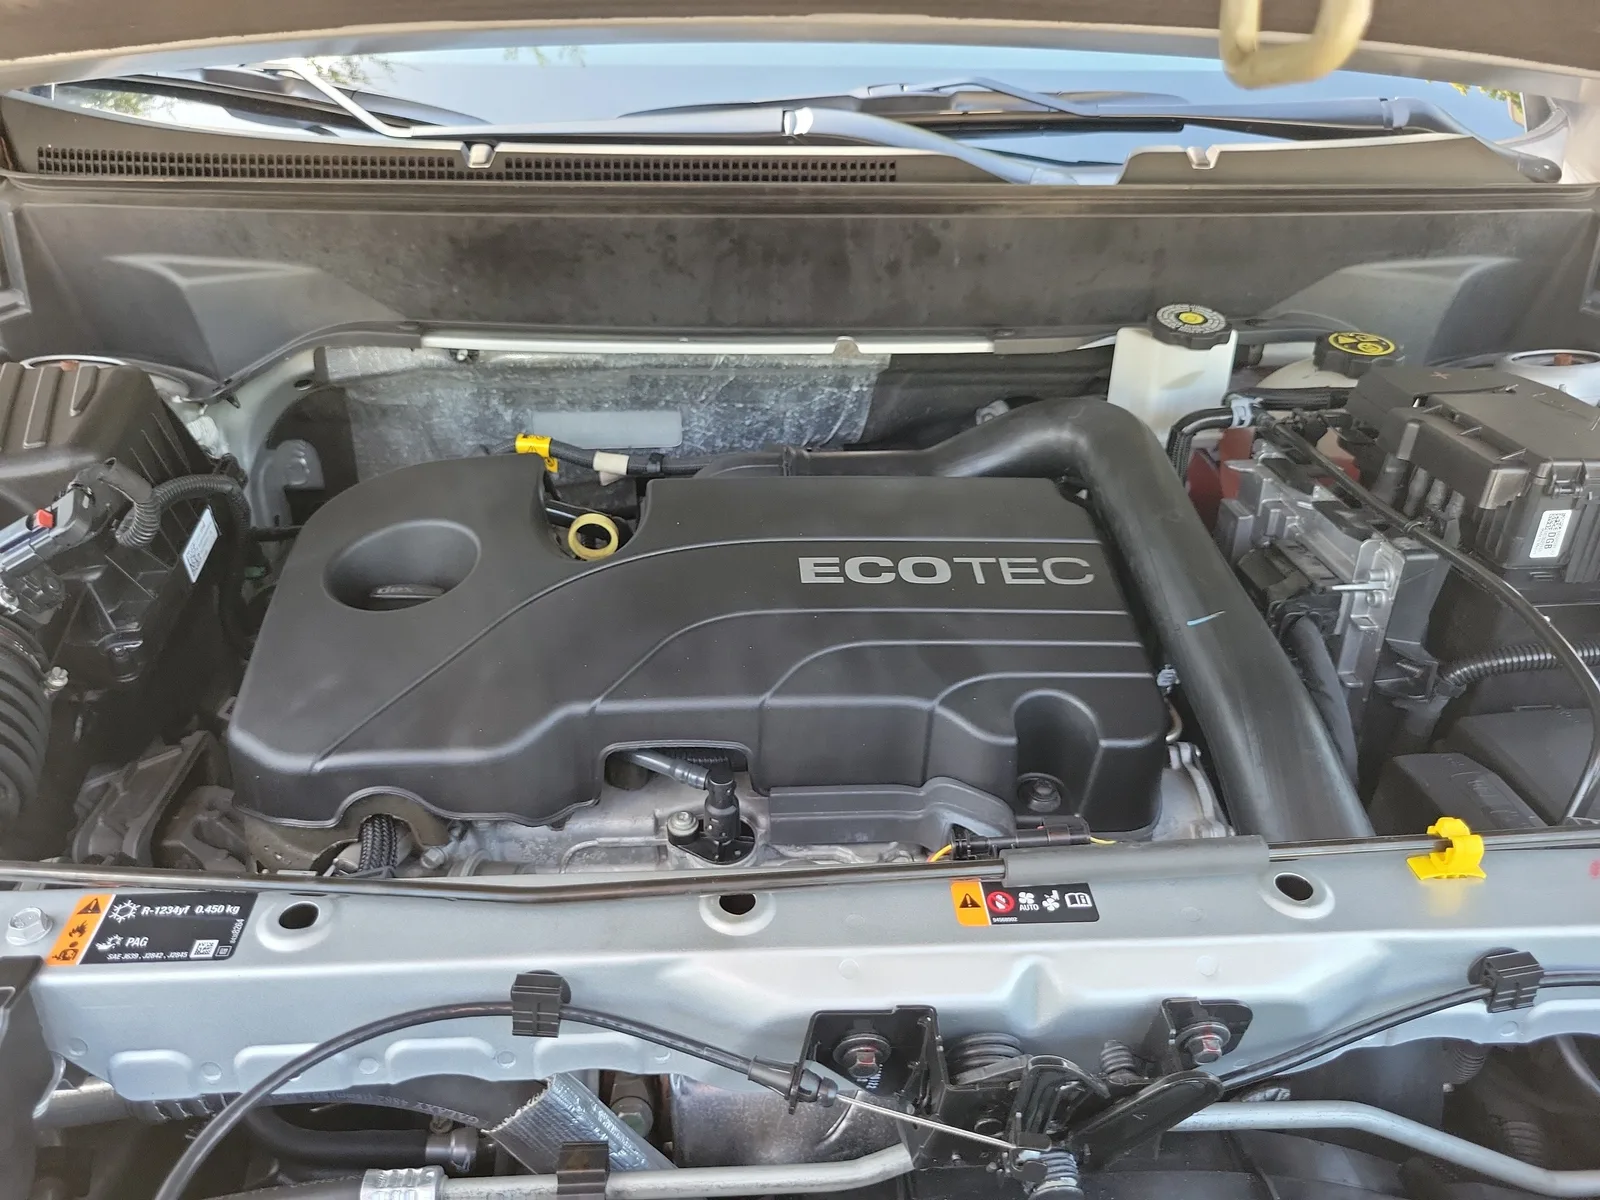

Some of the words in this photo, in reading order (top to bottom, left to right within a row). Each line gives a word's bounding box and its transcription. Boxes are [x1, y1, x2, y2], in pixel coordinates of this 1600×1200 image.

[798, 556, 1095, 585] ECOTEC
[141, 905, 190, 916] R-1234yf
[195, 904, 225, 915] 0.450
[225, 904, 241, 916] kg
[1019, 904, 1039, 912] AUTO
[125, 937, 149, 948] PAG
[415, 1102, 479, 1122] GALAXY
